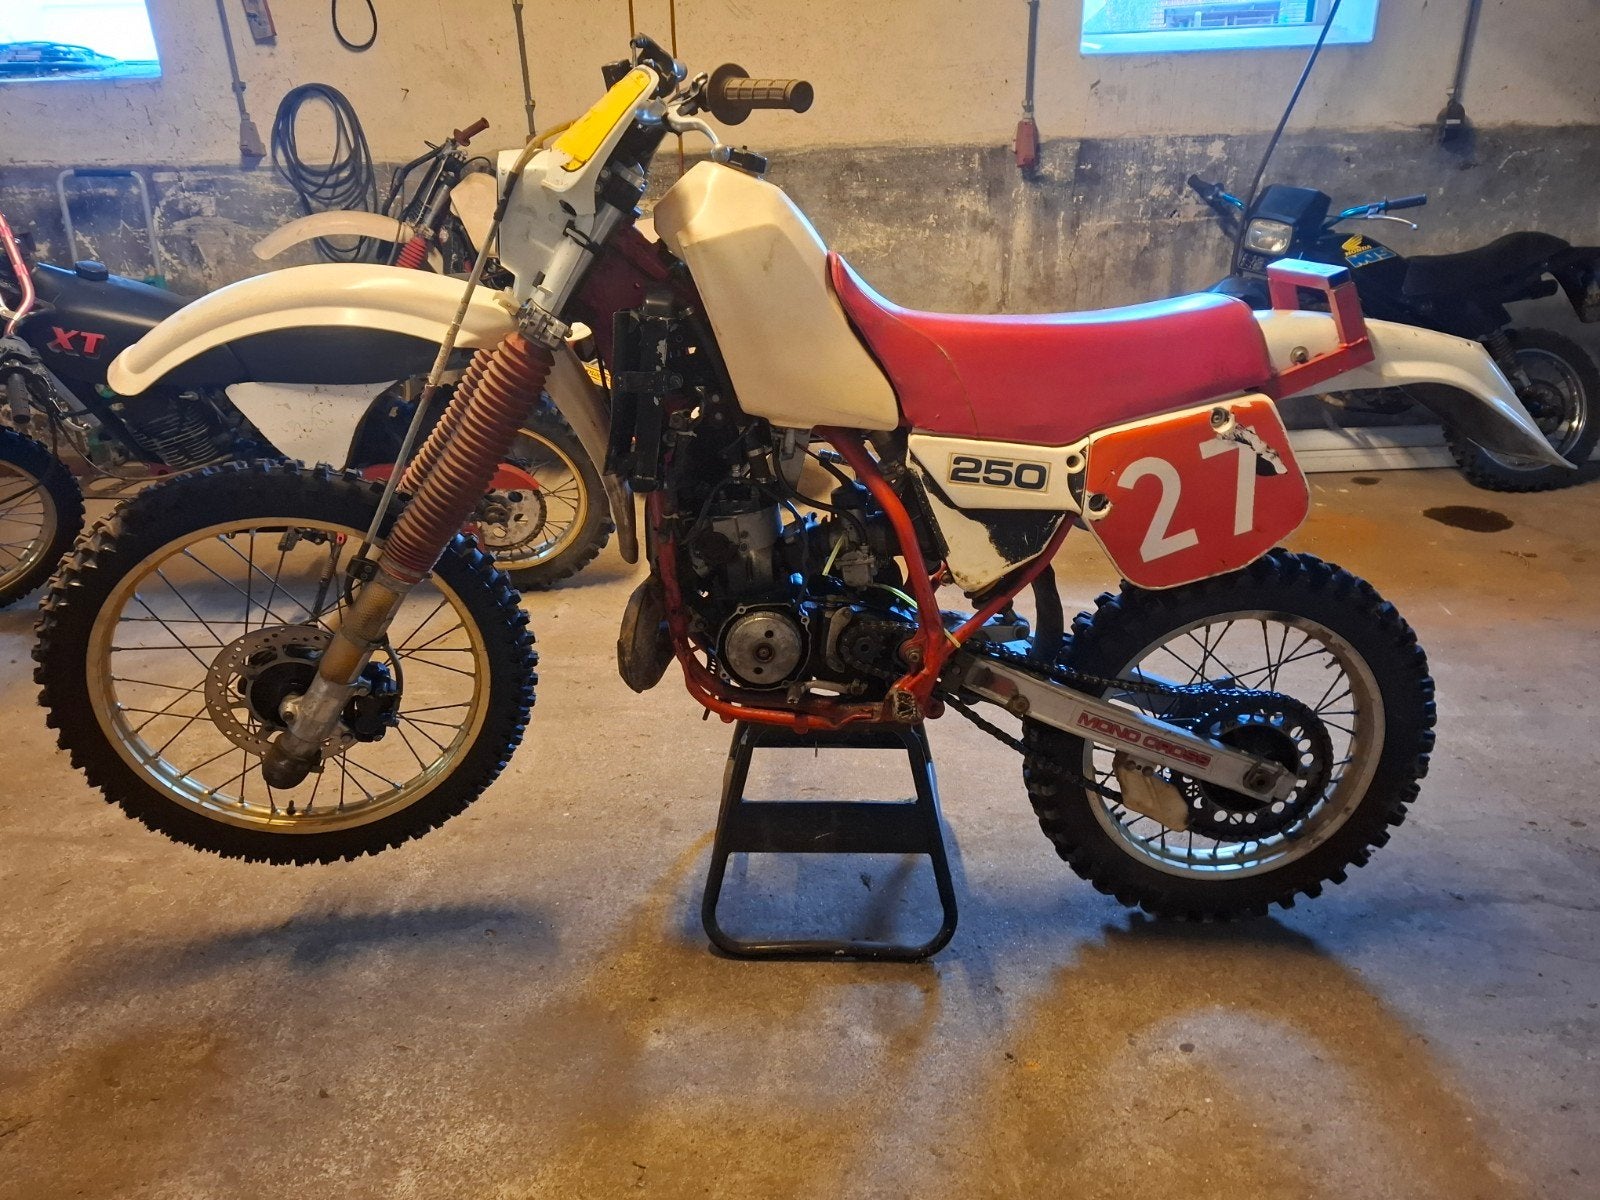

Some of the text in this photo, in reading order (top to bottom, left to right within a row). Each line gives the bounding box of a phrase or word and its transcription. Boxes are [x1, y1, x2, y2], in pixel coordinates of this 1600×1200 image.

[1345, 244, 1372, 257] HONDA
[48, 326, 106, 354] XT
[950, 456, 1047, 490] 250
[1117, 426, 1257, 563] 27
[1077, 712, 1212, 768] MONO CROSS
